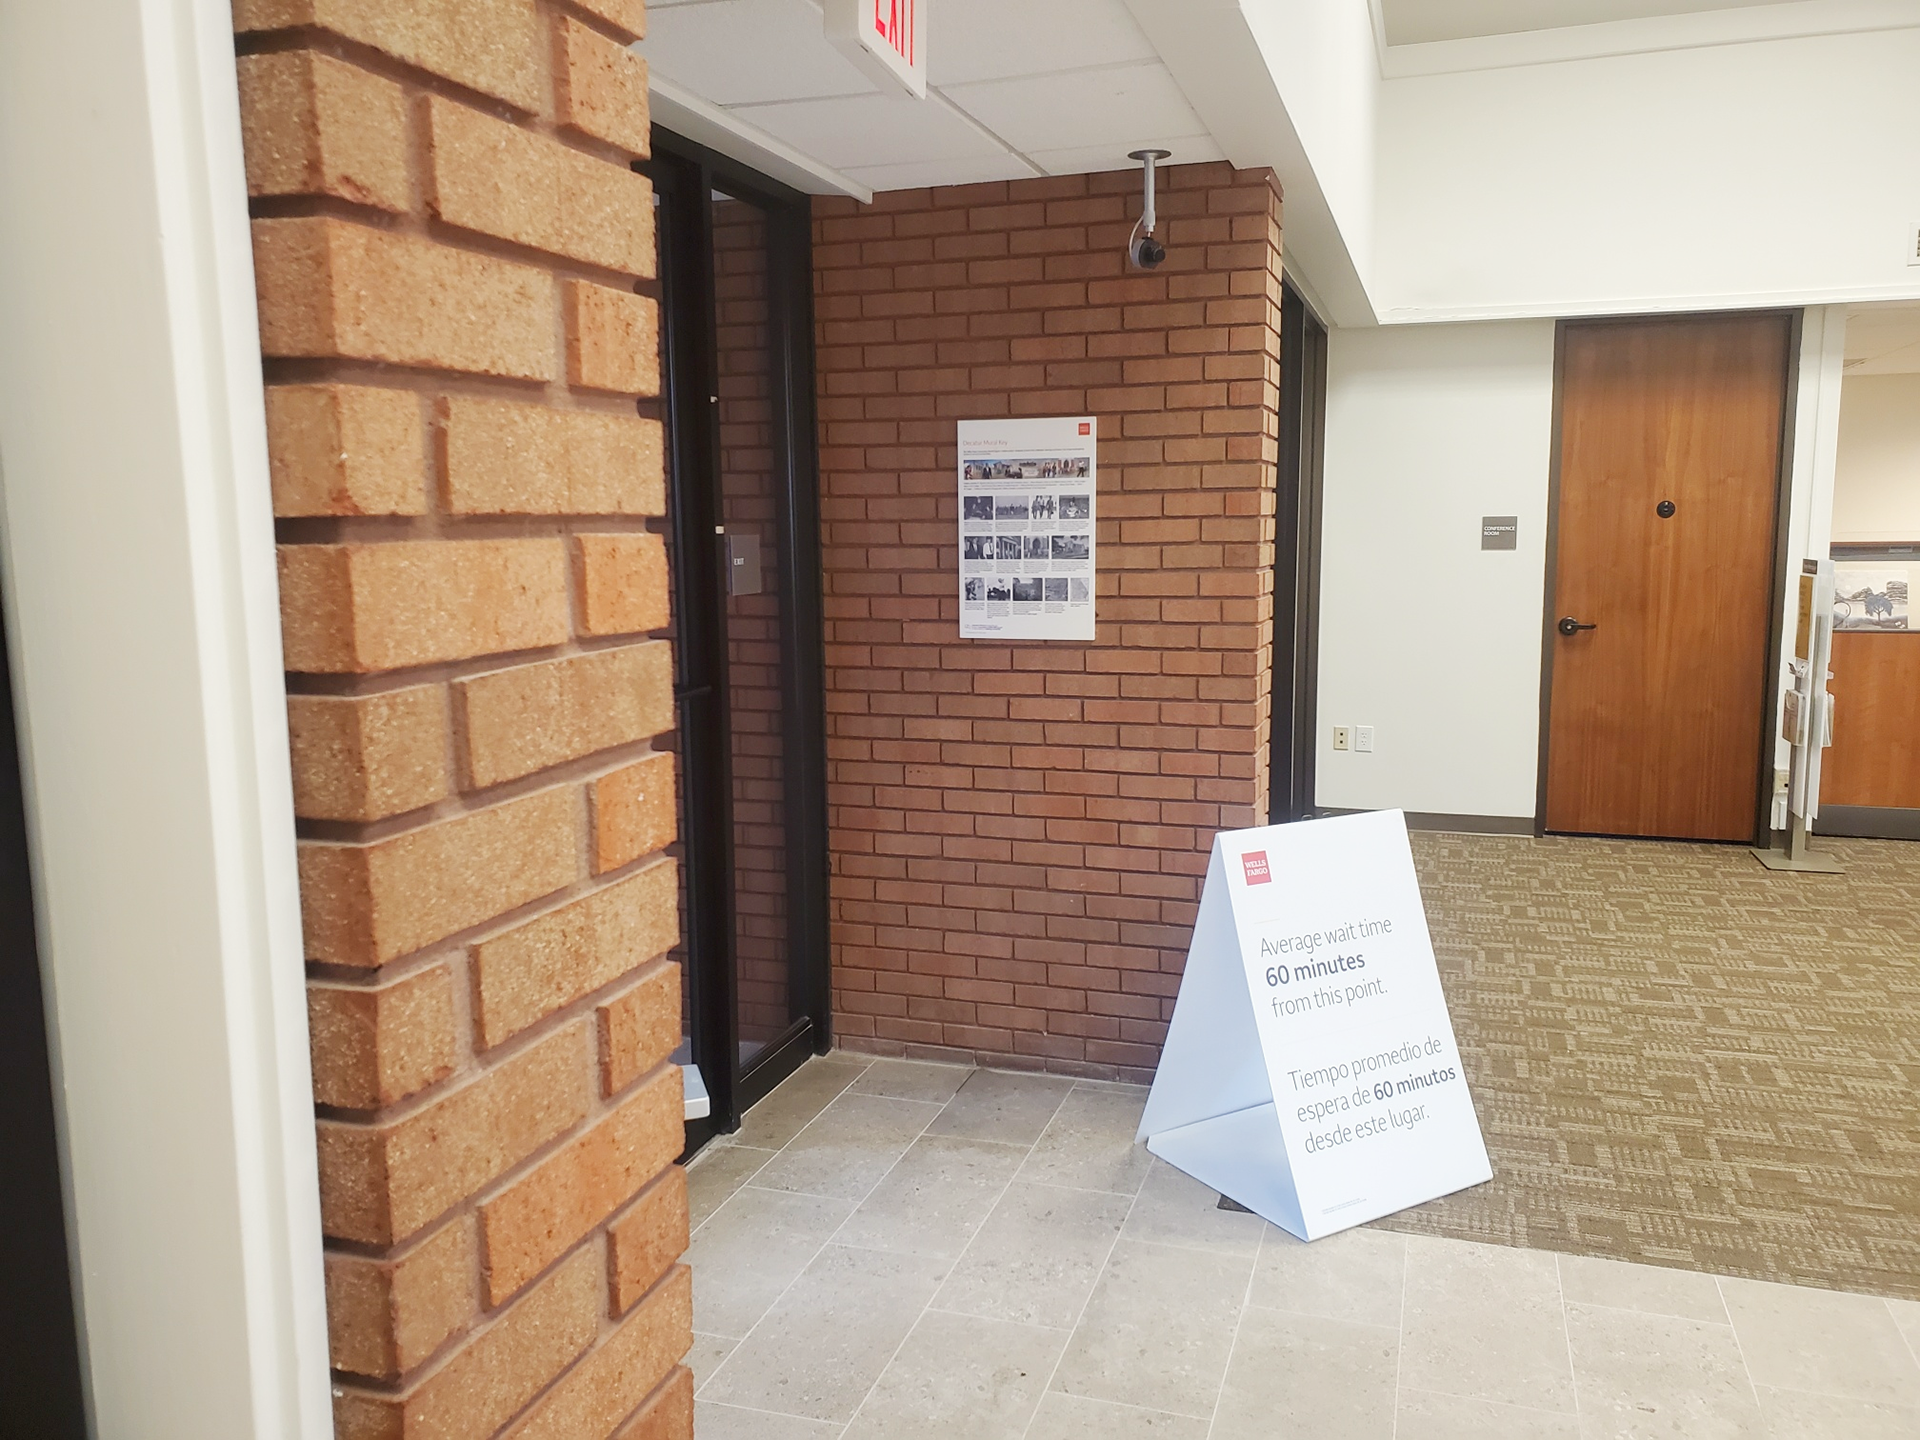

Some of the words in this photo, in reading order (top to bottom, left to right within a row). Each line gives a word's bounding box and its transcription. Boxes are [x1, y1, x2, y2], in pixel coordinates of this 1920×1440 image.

[1245, 860, 1266, 868] WELLS
[1247, 867, 1268, 876] FARGO
[1261, 932, 1322, 957] Average
[1324, 922, 1357, 944] wait
[1359, 918, 1393, 938] time
[1266, 964, 1290, 987] 60
[1294, 954, 1365, 981] minutes
[1271, 996, 1312, 1017] from
[1313, 985, 1343, 1008] this
[1345, 977, 1388, 1007] point.
[1287, 1063, 1349, 1091] Tiempo
[1351, 1041, 1421, 1080] promedio
[1424, 1035, 1442, 1056] de
[1297, 1095, 1350, 1123] espera
[1352, 1086, 1372, 1107] de
[1374, 1081, 1393, 1100] 60
[1396, 1067, 1456, 1095] minutos
[1304, 1123, 1353, 1153] desde
[1355, 1116, 1387, 1139] este
[1388, 1104, 1430, 1130] lugar.
